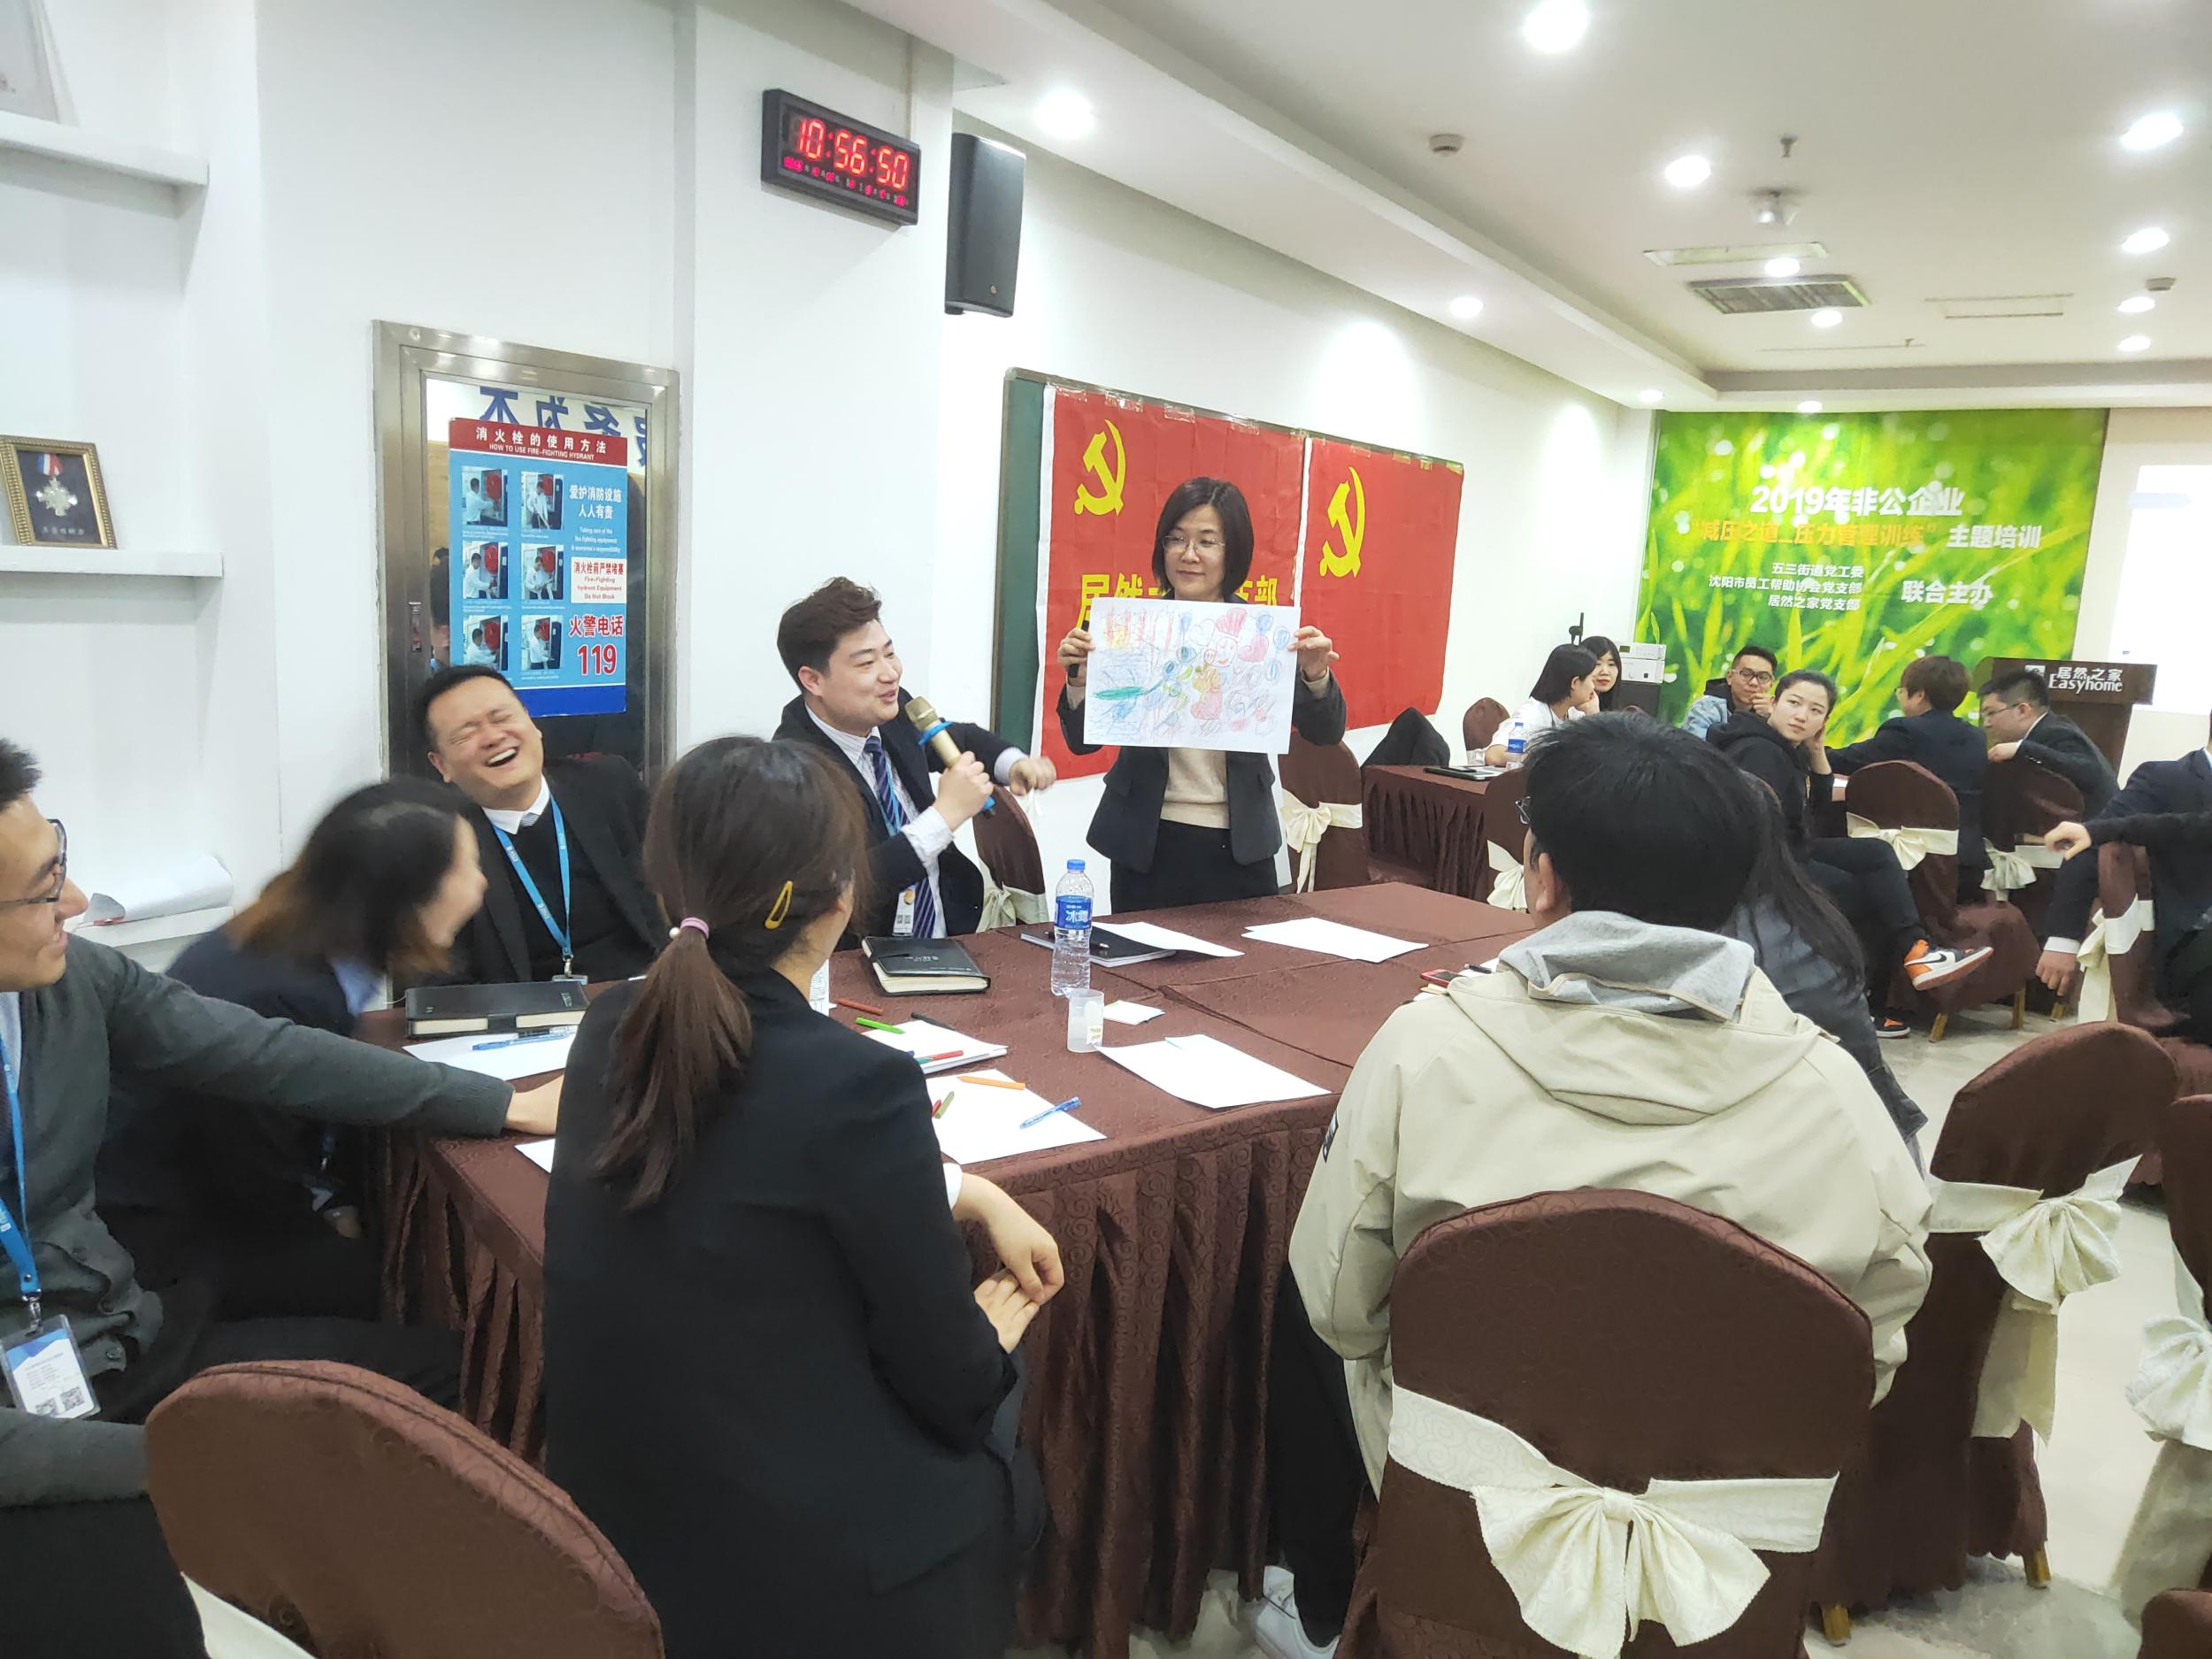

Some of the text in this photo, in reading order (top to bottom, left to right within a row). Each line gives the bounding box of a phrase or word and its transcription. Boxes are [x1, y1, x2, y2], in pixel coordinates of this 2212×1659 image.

[798, 119, 910, 190] 10:56:50
[475, 426, 607, 454] 消火栓的使用方法
[527, 447, 568, 458] FIRE-FIGHTING
[569, 452, 595, 461] HYDRANT
[569, 485, 623, 503] 爱护消防设施
[1750, 486, 1966, 518] 2019年非公企业
[579, 503, 614, 519] 人人有责
[1947, 524, 2042, 549] 主题培训
[574, 562, 624, 575] 消火栓前严禁堵塞
[1771, 563, 1863, 579] 五三街道党工委
[1768, 594, 1862, 611] 居然之家党支部
[1901, 580, 1993, 606] 联合主办
[568, 614, 624, 637] 火警电话
[577, 644, 617, 675] 119
[2048, 673, 2124, 694] Easyhome
[2057, 666, 2124, 682] 居然之家
